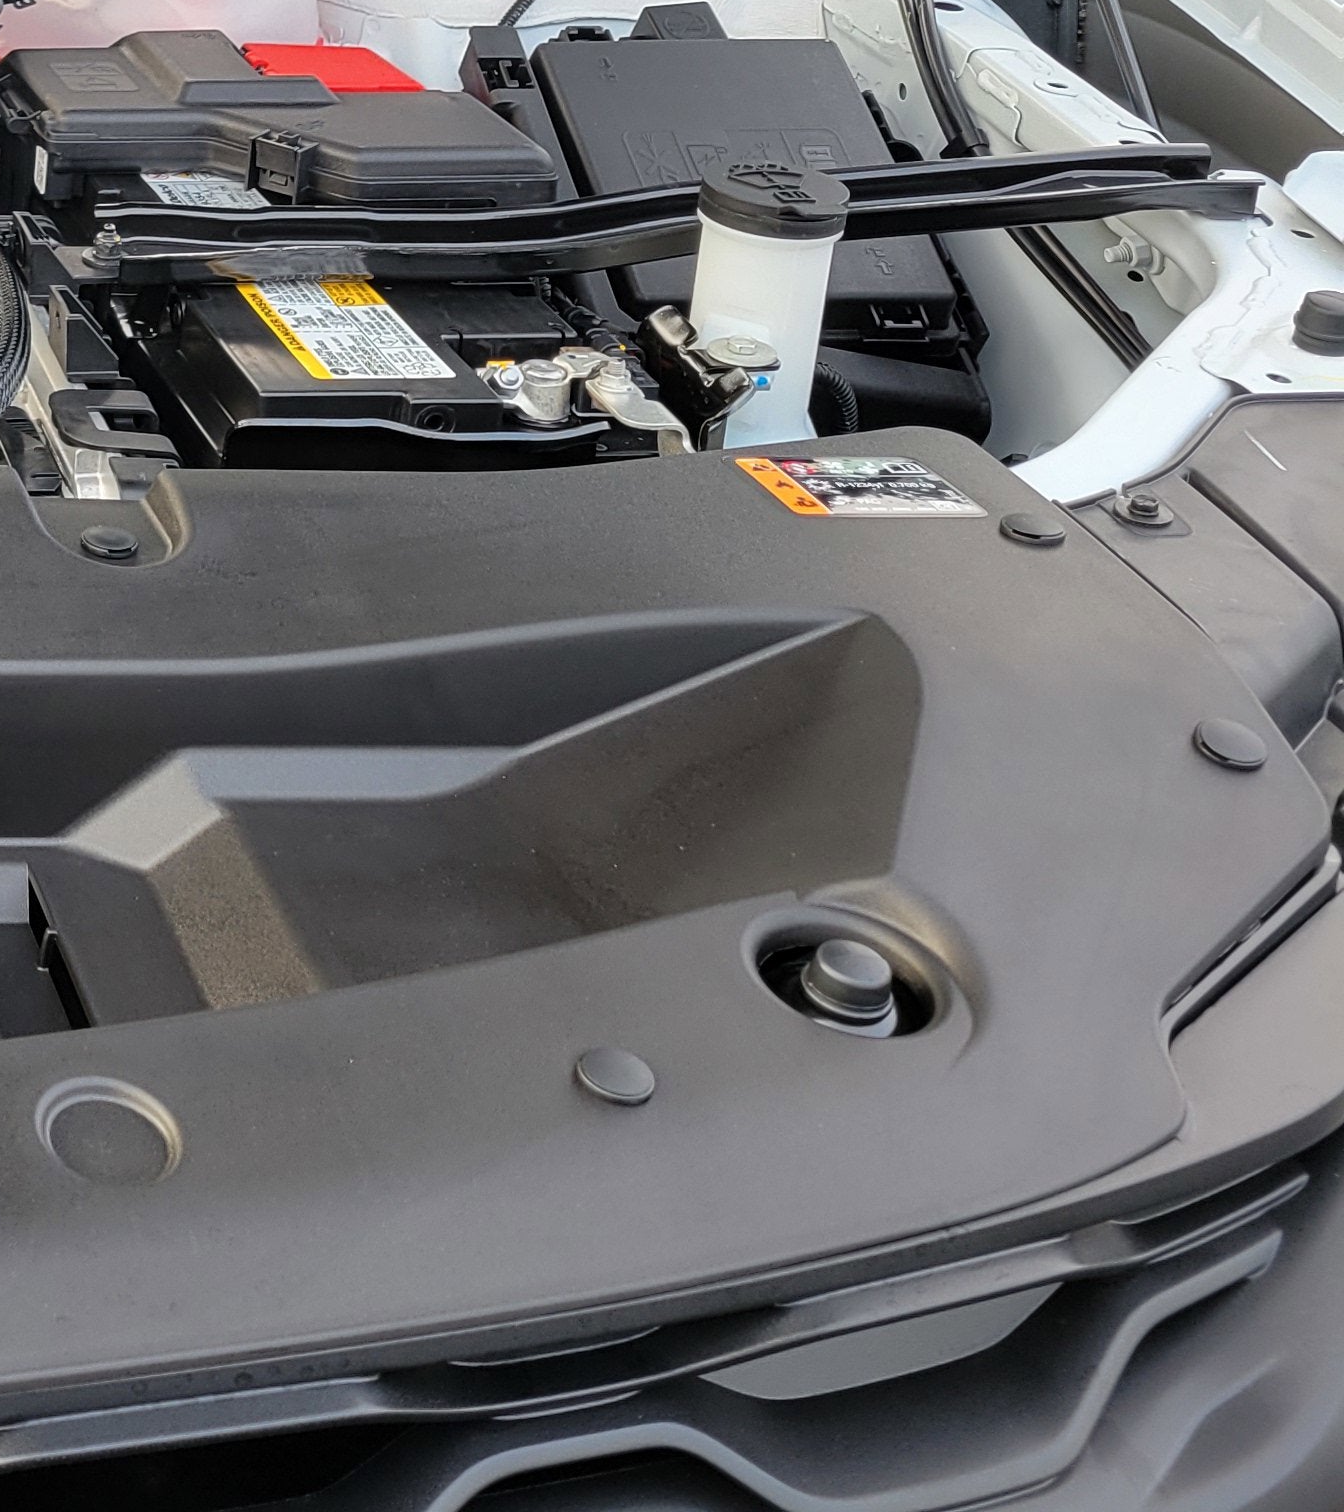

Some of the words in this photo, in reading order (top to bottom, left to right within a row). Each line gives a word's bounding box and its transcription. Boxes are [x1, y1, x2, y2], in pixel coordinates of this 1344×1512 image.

[247, 293, 276, 318] POISON
[270, 319, 301, 346] DANGER
[834, 481, 884, 489] R-1234yf
